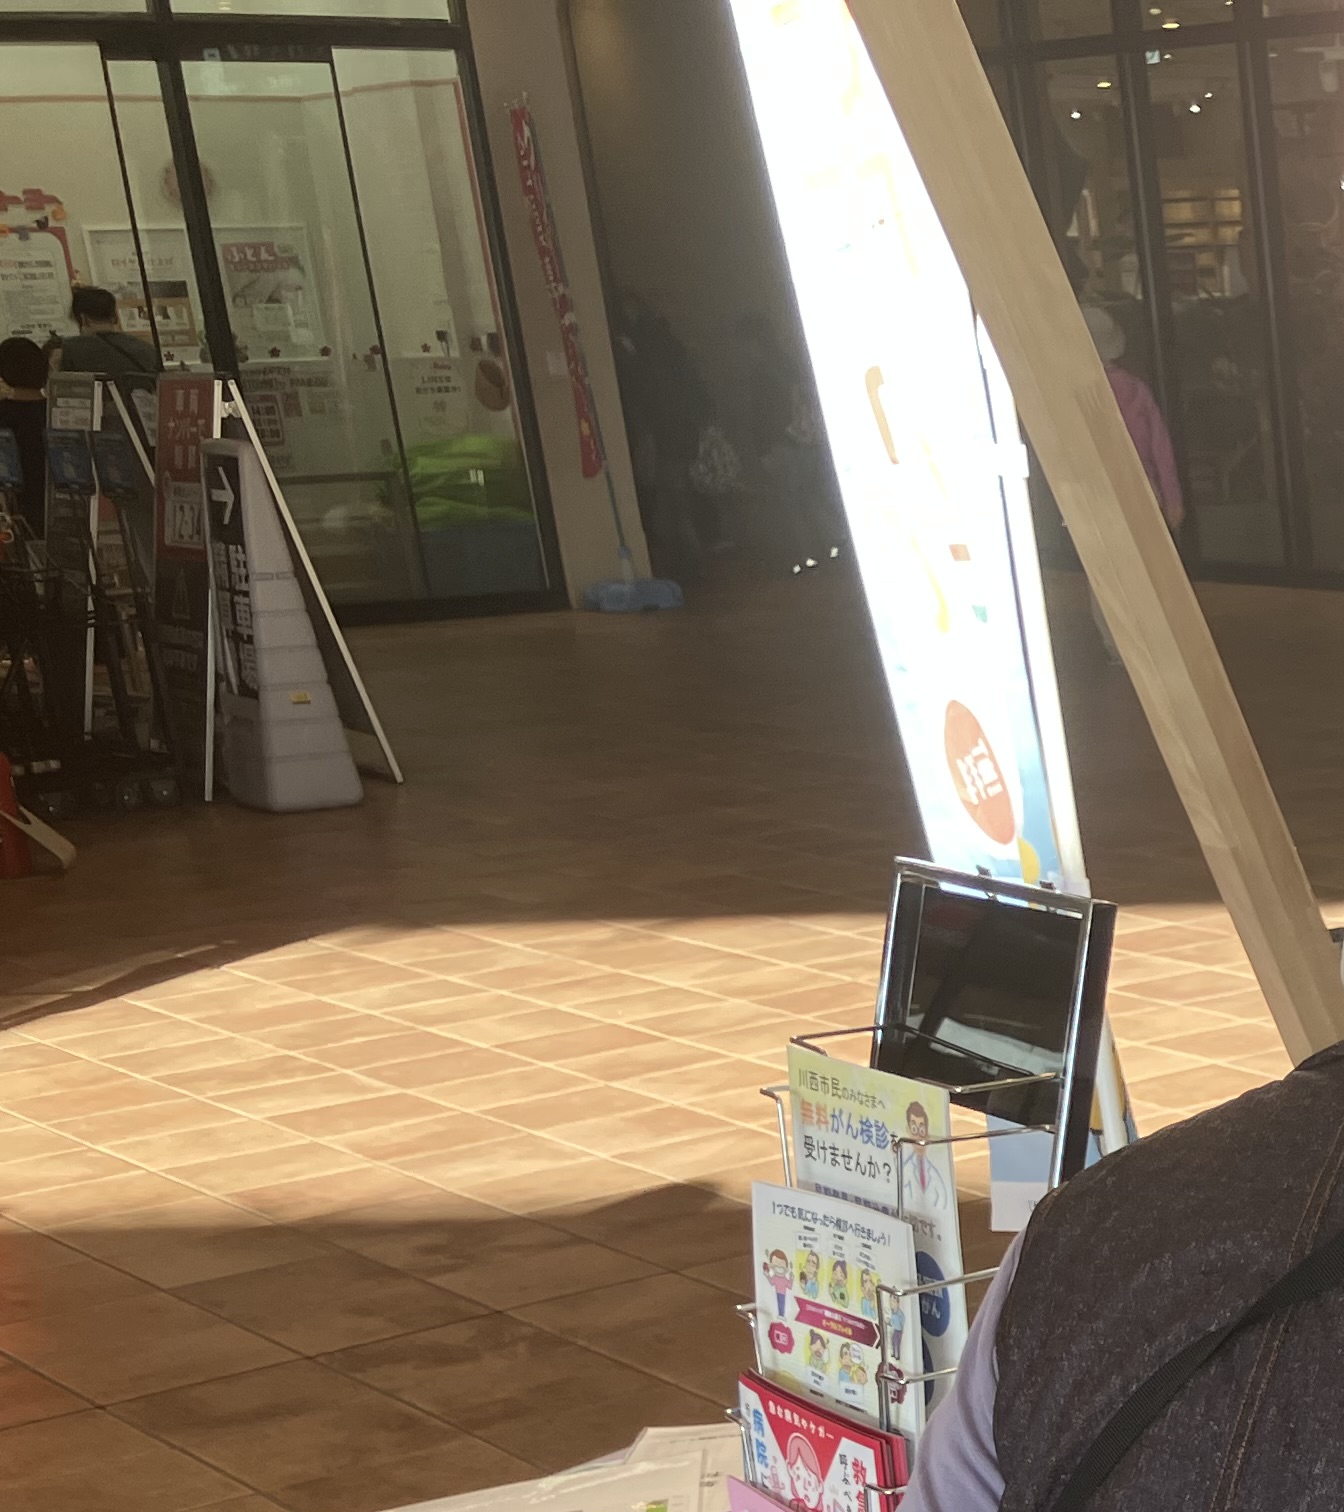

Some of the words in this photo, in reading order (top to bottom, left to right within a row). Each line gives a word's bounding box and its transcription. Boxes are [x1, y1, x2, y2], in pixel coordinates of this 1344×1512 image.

[798, 1069, 886, 1110] 川西市民のみなさまへ
[800, 1096, 901, 1155] 無料がん検診を
